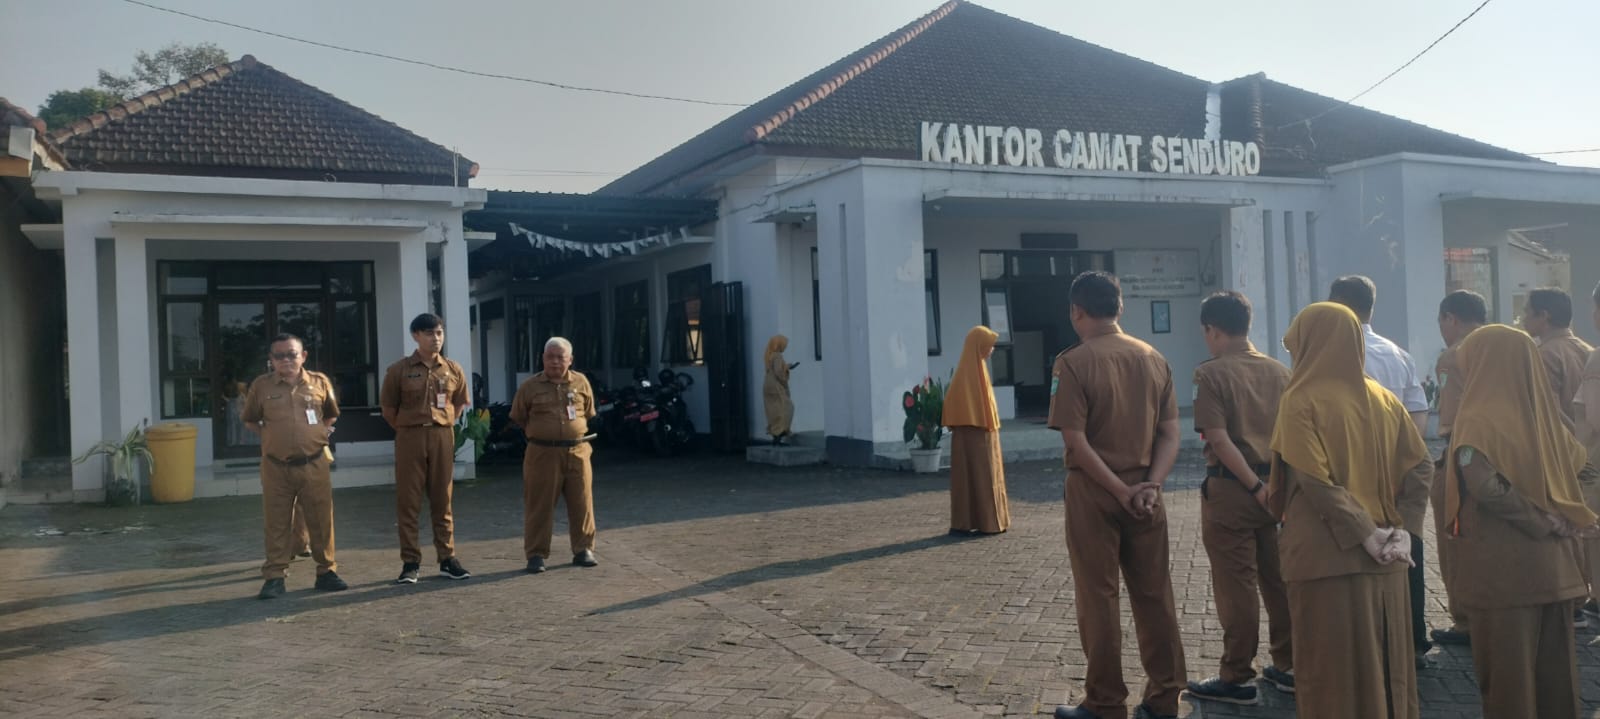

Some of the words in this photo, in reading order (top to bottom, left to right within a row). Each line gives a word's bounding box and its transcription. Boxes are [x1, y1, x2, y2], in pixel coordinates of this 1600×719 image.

[921, 120, 1044, 168] KANTOR
[1053, 128, 1142, 172] CAMAT
[1152, 134, 1261, 177] SENDURO
